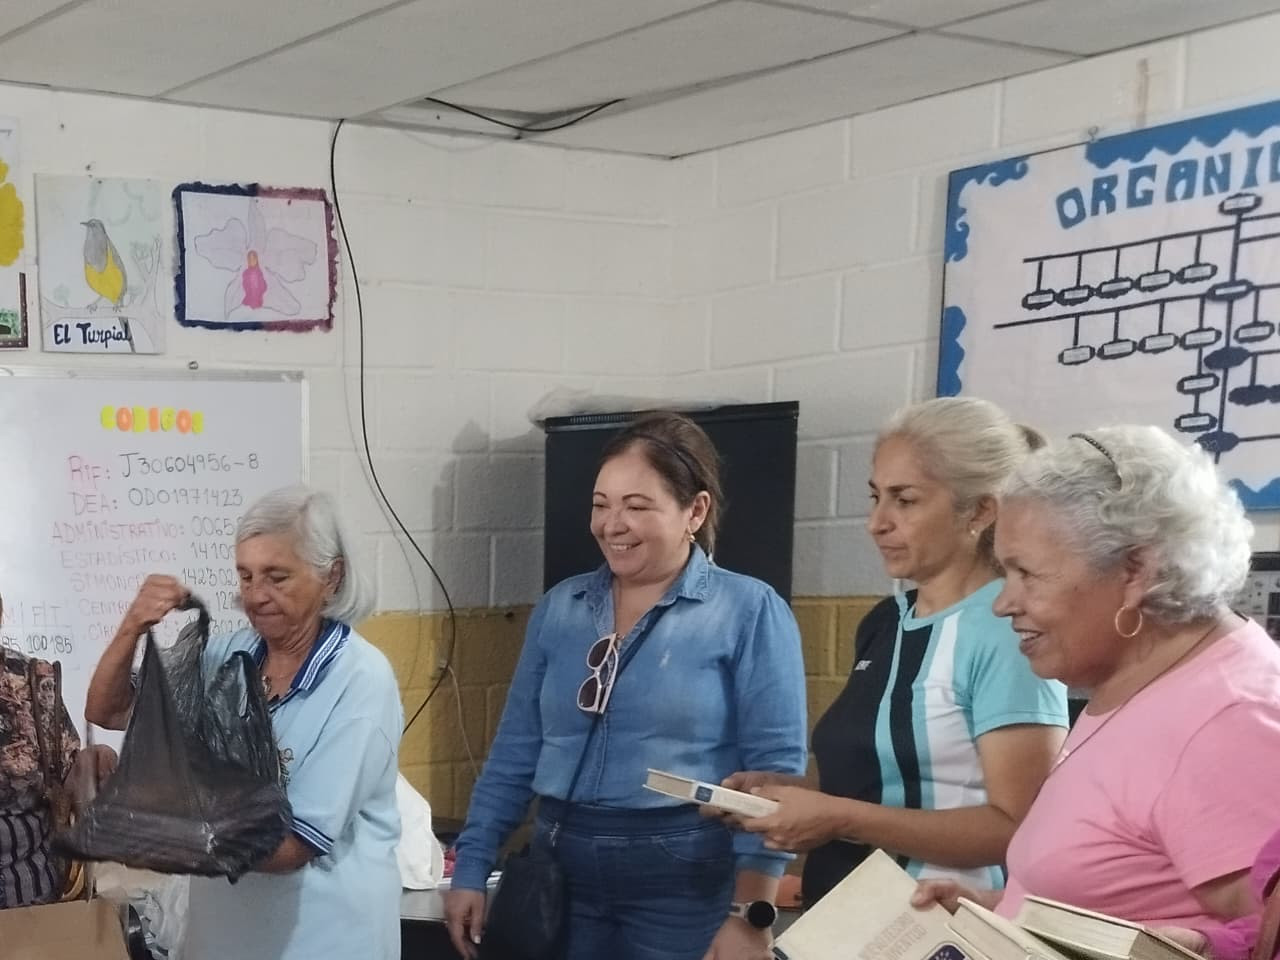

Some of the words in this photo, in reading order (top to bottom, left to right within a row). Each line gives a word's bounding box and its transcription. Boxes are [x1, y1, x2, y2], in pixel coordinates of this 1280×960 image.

[54, 324, 71, 345] El
[80, 322, 131, 350] Turpial
[118, 452, 260, 477] J30604956-8
[68, 491, 118, 516] DEA:
[191, 515, 244, 537] 0065
[26, 634, 47, 654] 100
[50, 635, 73, 655] 185
